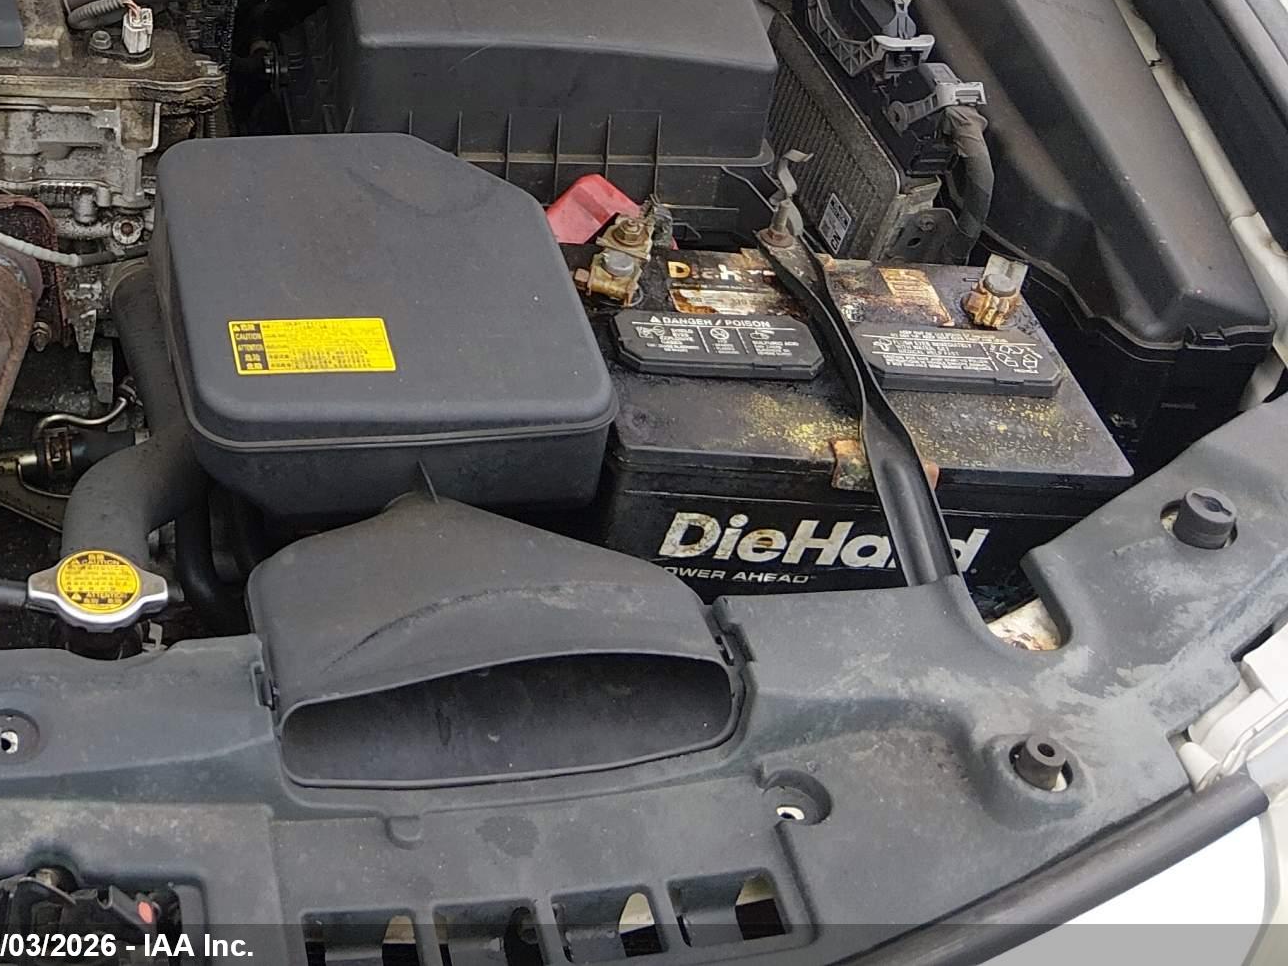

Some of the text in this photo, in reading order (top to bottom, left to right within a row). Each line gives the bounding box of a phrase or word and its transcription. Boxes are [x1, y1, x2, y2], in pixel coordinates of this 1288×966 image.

[662, 316, 713, 325] DANGER
[724, 319, 771, 328] POISON
[659, 512, 990, 572] DieHad
[663, 566, 809, 584] OWER AHEAD
